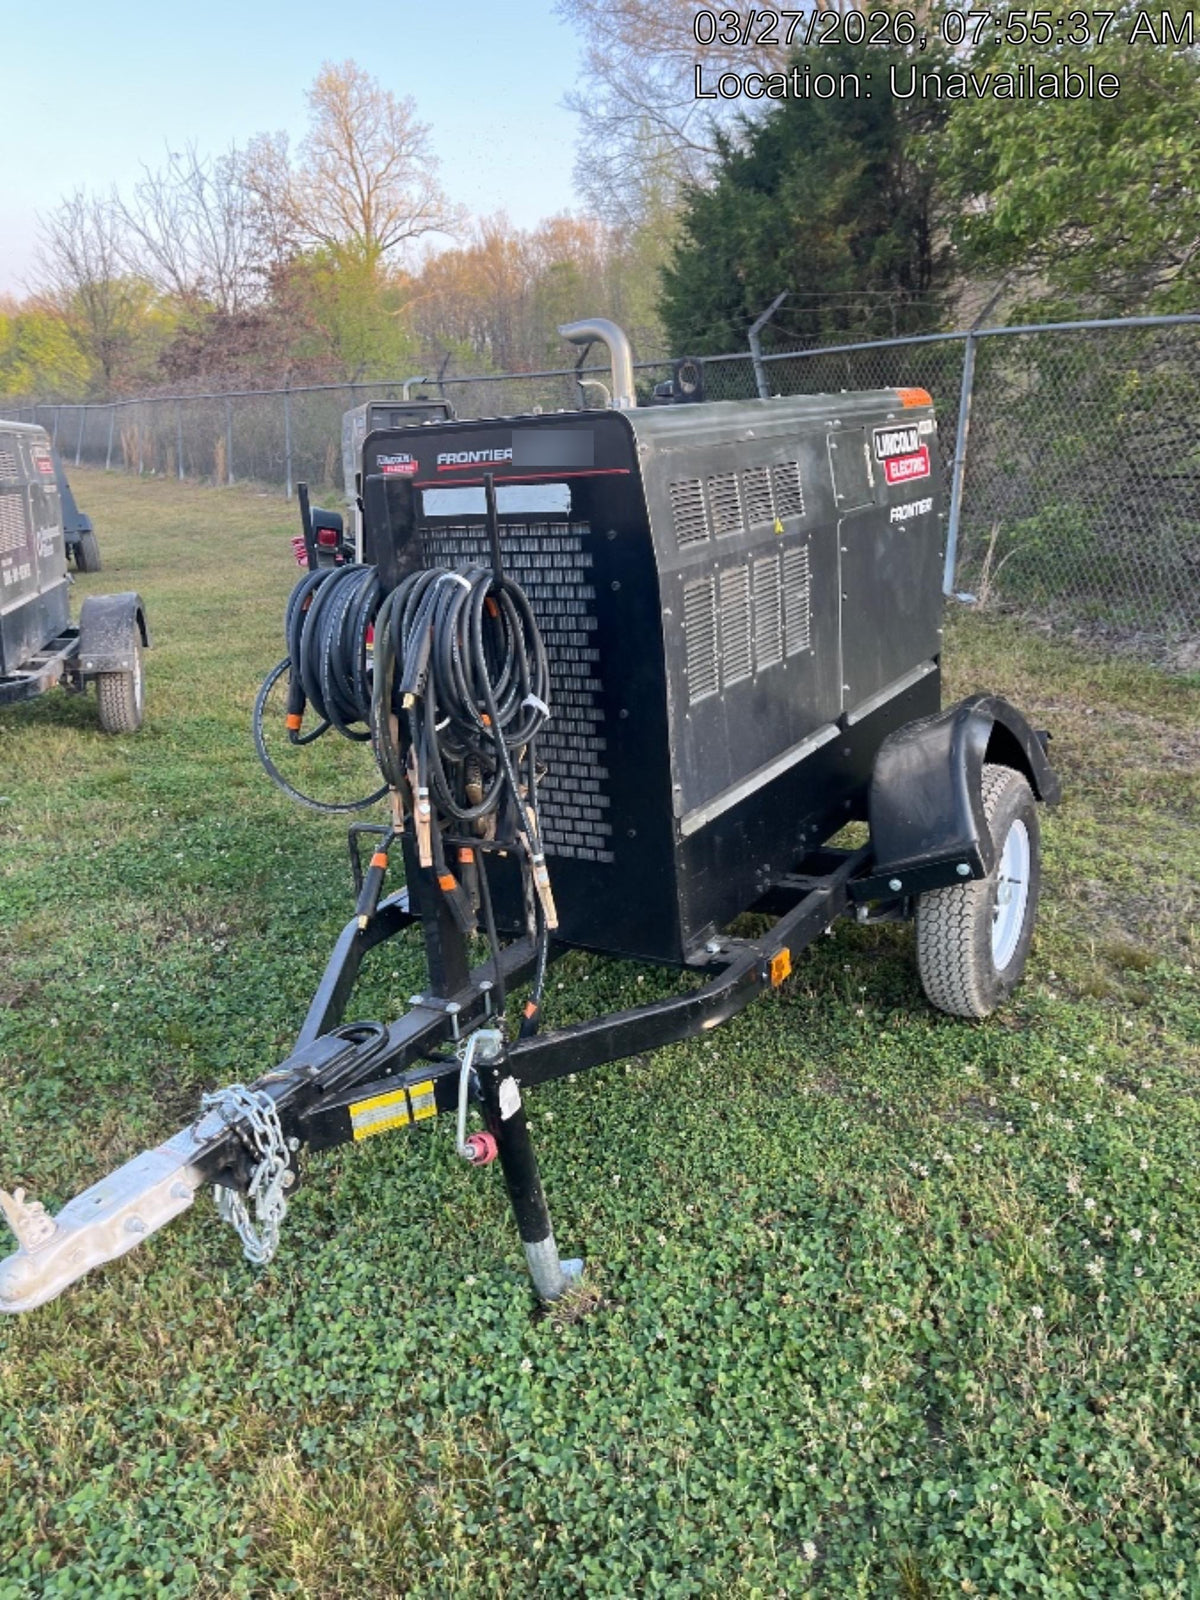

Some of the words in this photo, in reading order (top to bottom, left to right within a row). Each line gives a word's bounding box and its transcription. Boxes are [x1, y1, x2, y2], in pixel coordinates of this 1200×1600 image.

[876, 430, 918, 458] LINCOLN
[890, 457, 925, 478] ELECTRIC
[890, 498, 933, 523] FRONTIER
